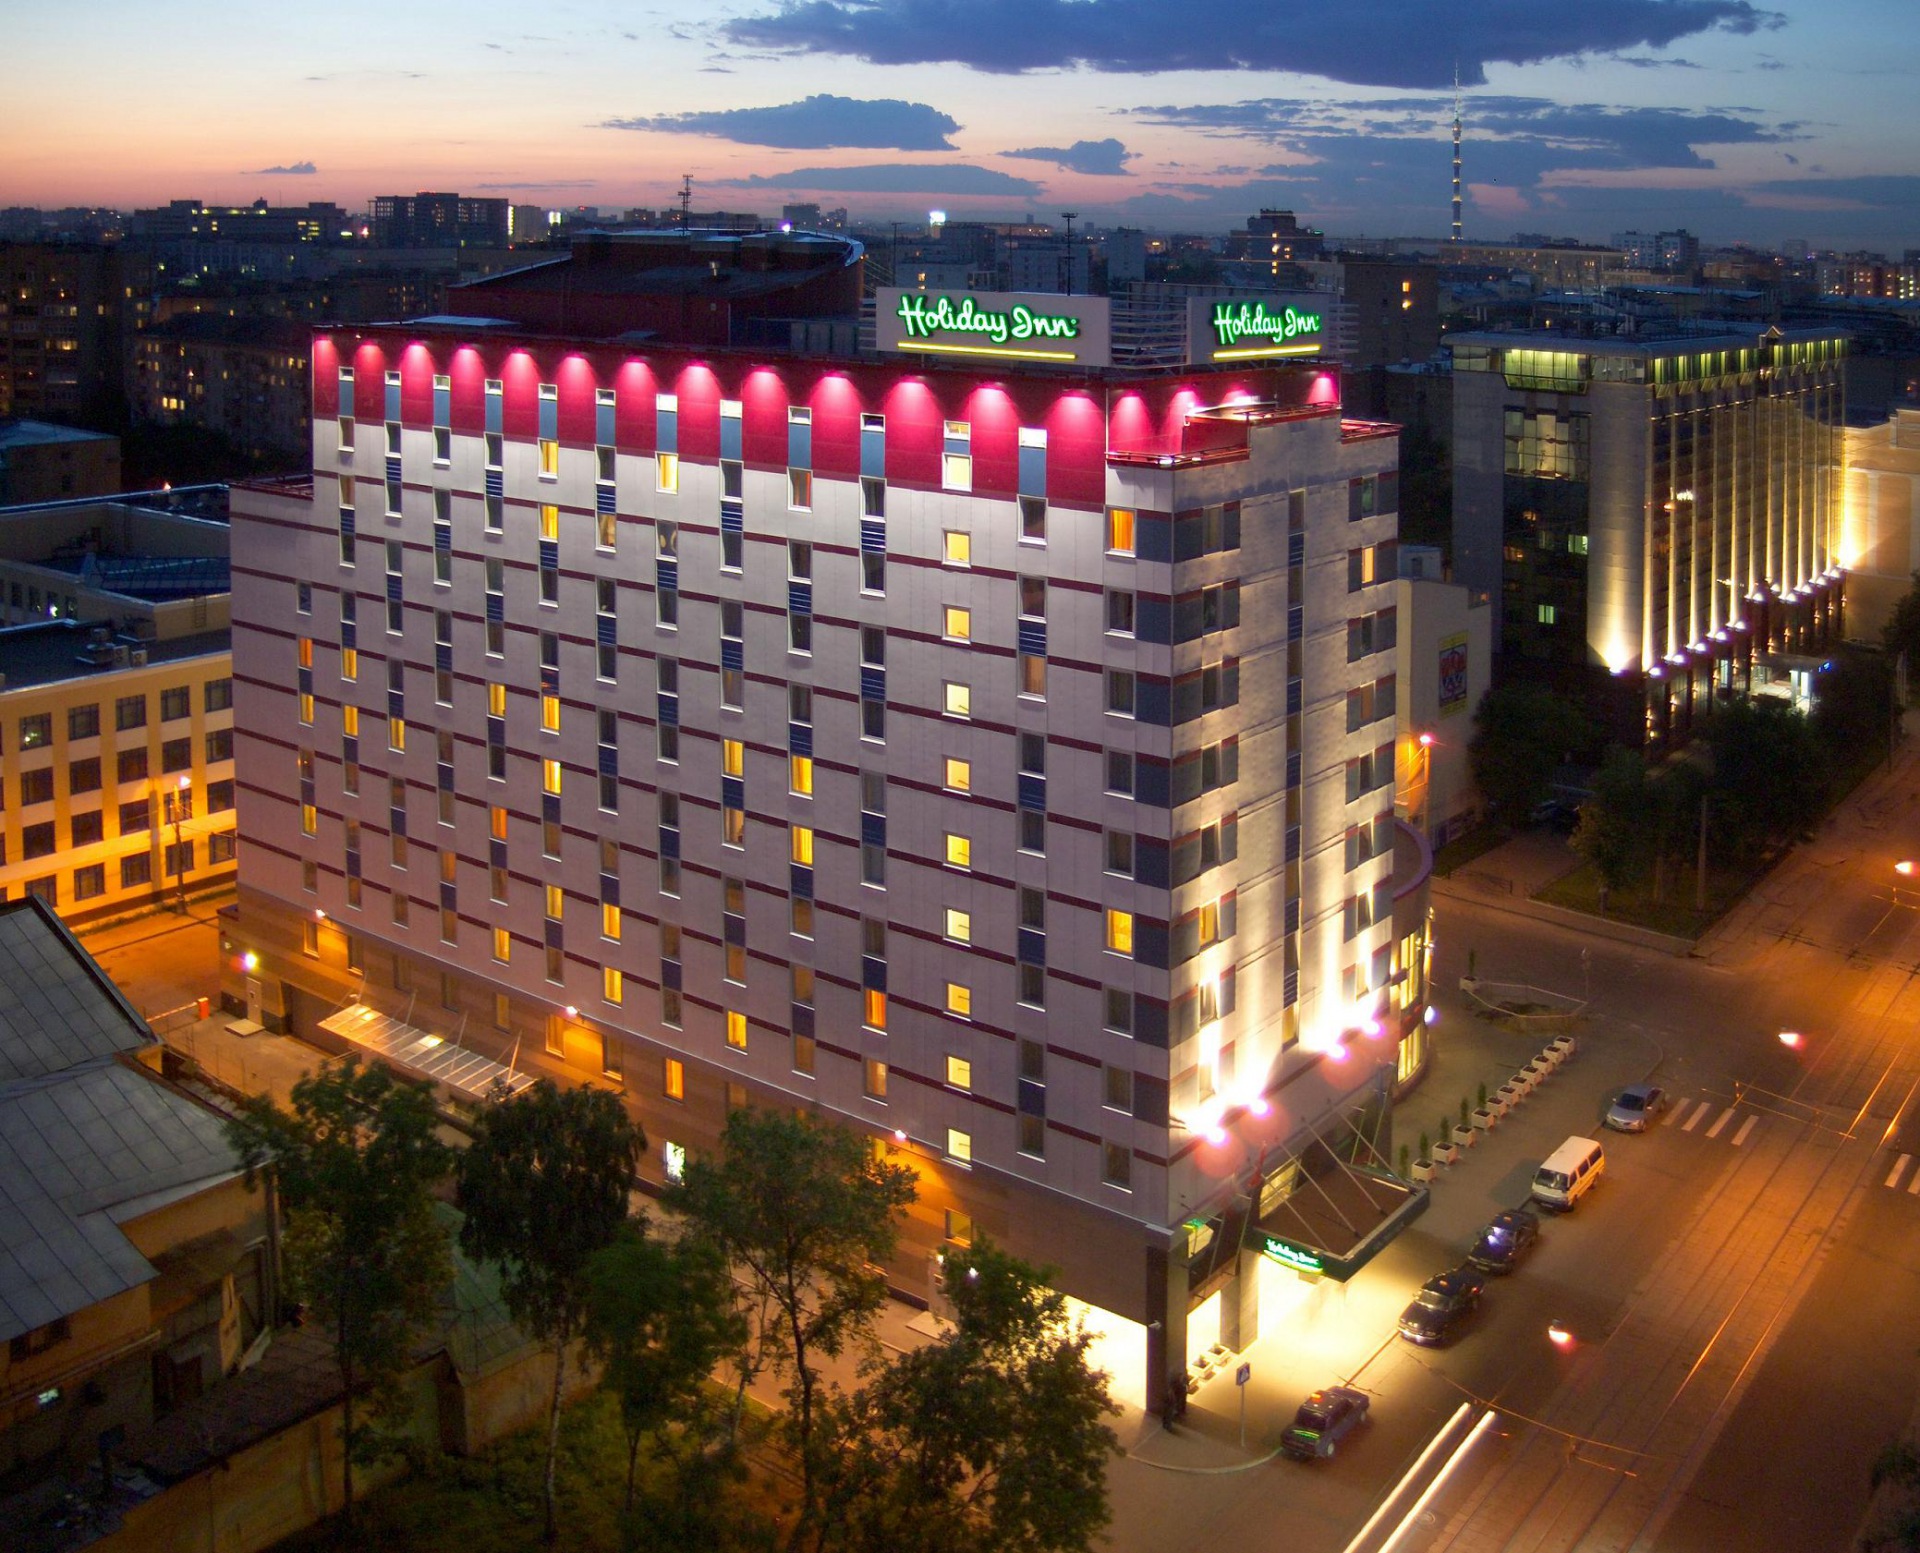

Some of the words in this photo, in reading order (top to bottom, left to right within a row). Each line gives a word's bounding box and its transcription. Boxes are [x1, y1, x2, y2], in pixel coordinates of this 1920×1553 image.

[897, 295, 1008, 343] Holiday
[1012, 304, 1077, 338] Inn
[1213, 303, 1282, 344] Holiday
[1285, 308, 1320, 337] Inn
